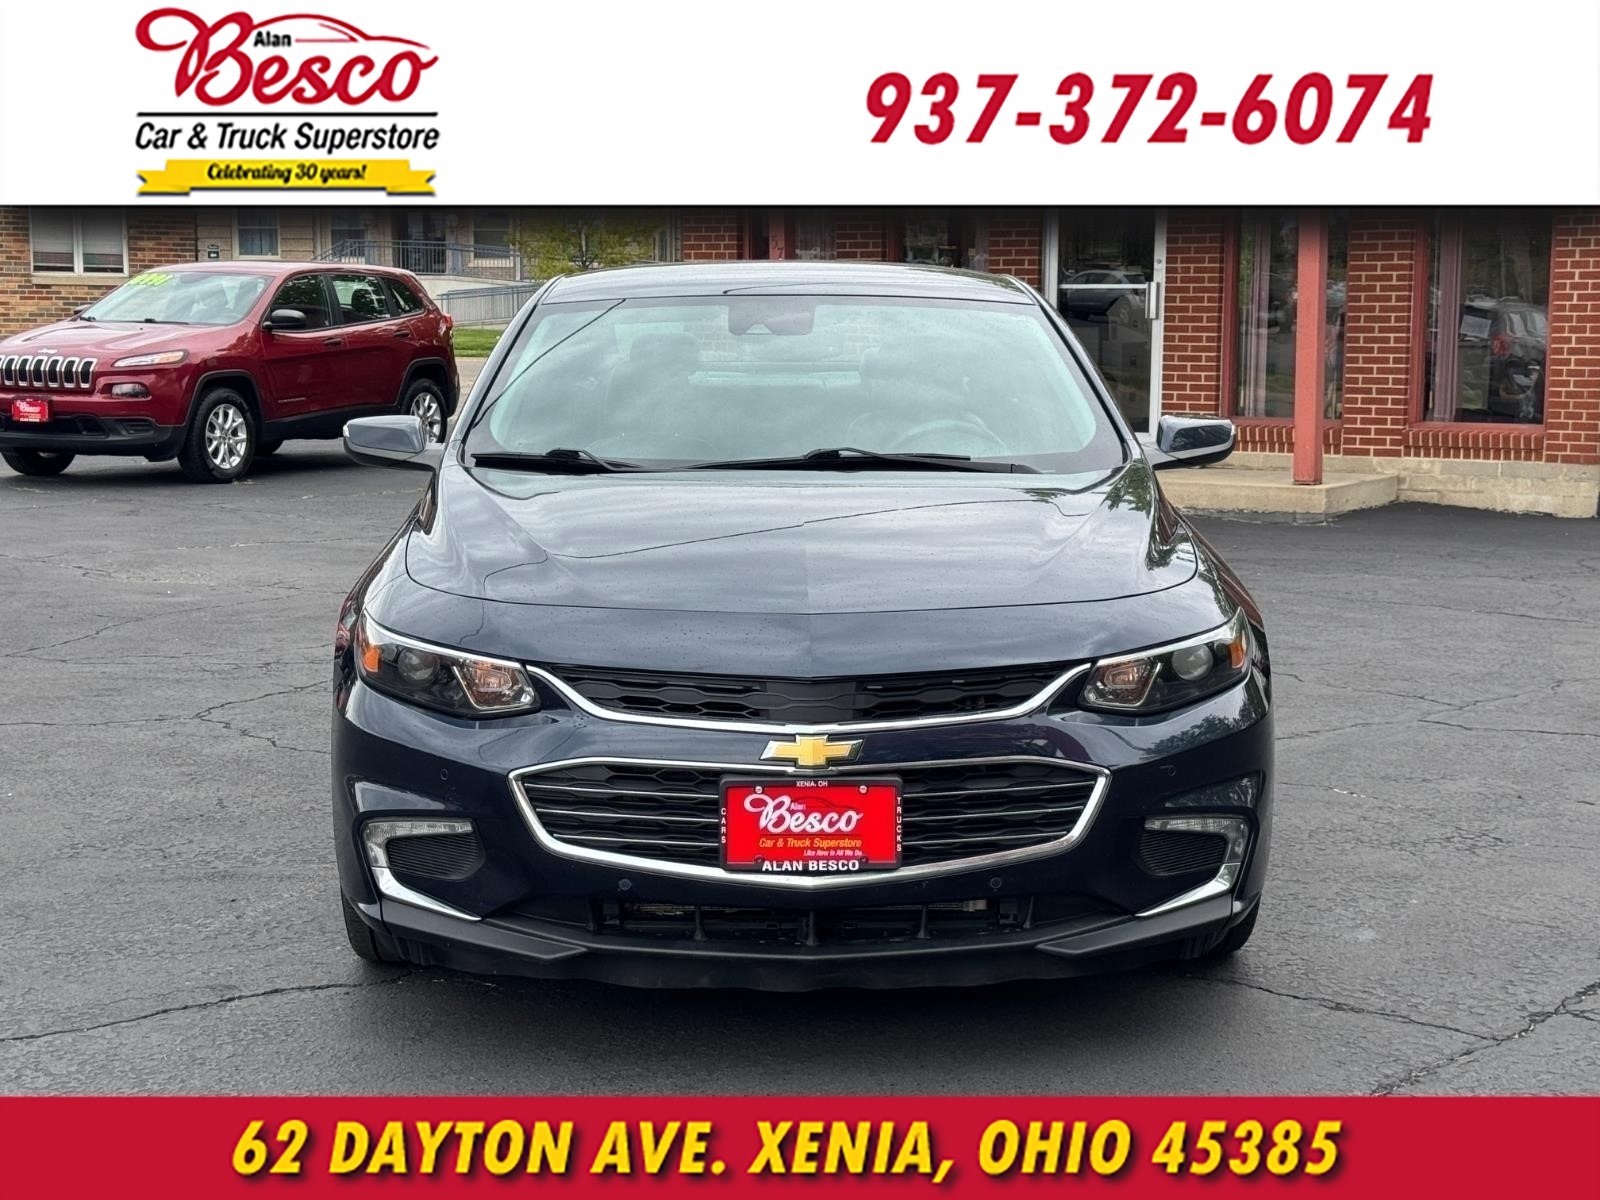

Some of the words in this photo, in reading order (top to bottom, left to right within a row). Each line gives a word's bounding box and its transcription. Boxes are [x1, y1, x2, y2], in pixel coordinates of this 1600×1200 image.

[818, 780, 828, 788] OH
[790, 802, 806, 811] Alan
[744, 793, 863, 833] Besco
[759, 838, 775, 848] Car
[777, 838, 784, 848] &
[787, 838, 811, 848] Truck
[813, 838, 862, 849] Superstore
[762, 860, 803, 871] ALAN
[808, 860, 859, 871] BESCO
